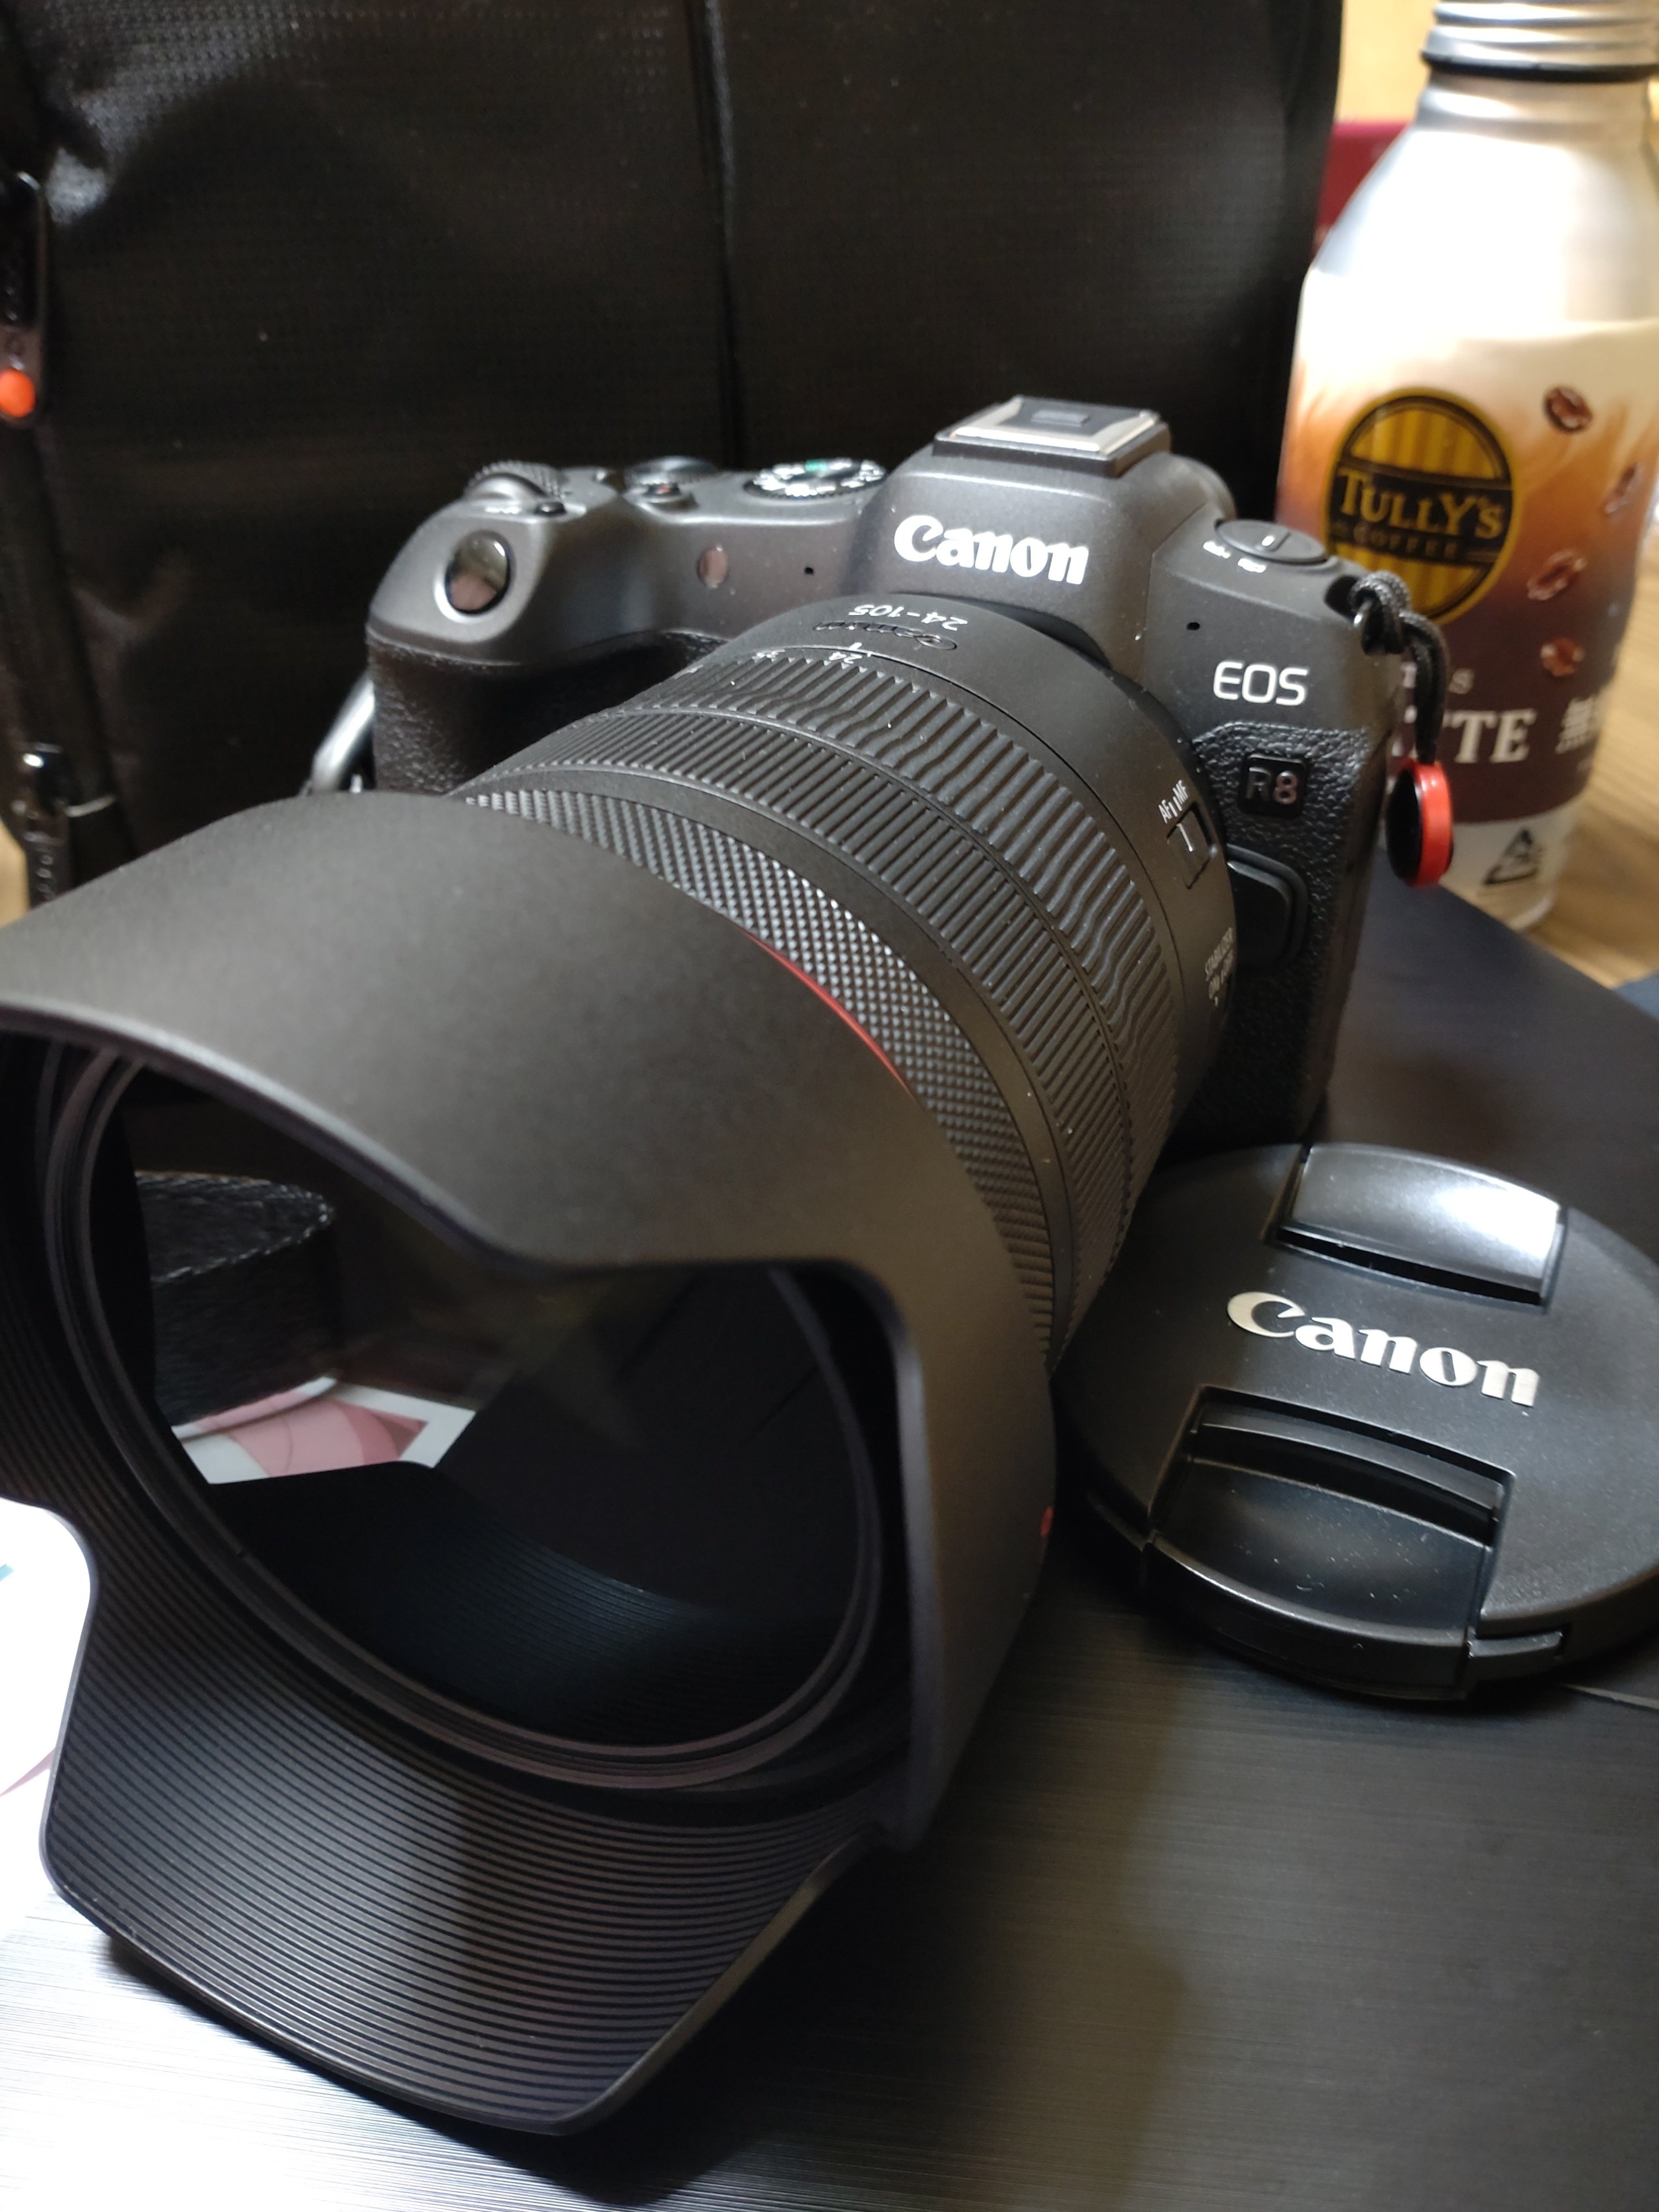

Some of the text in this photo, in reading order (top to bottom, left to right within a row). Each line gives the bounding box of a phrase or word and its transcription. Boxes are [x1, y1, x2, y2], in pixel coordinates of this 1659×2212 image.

[894, 515, 1089, 585] Canon
[848, 604, 968, 632] 24-105
[1213, 661, 1309, 706] EOS
[1247, 766, 1298, 805] R8
[1227, 1291, 1540, 1407] Canon
